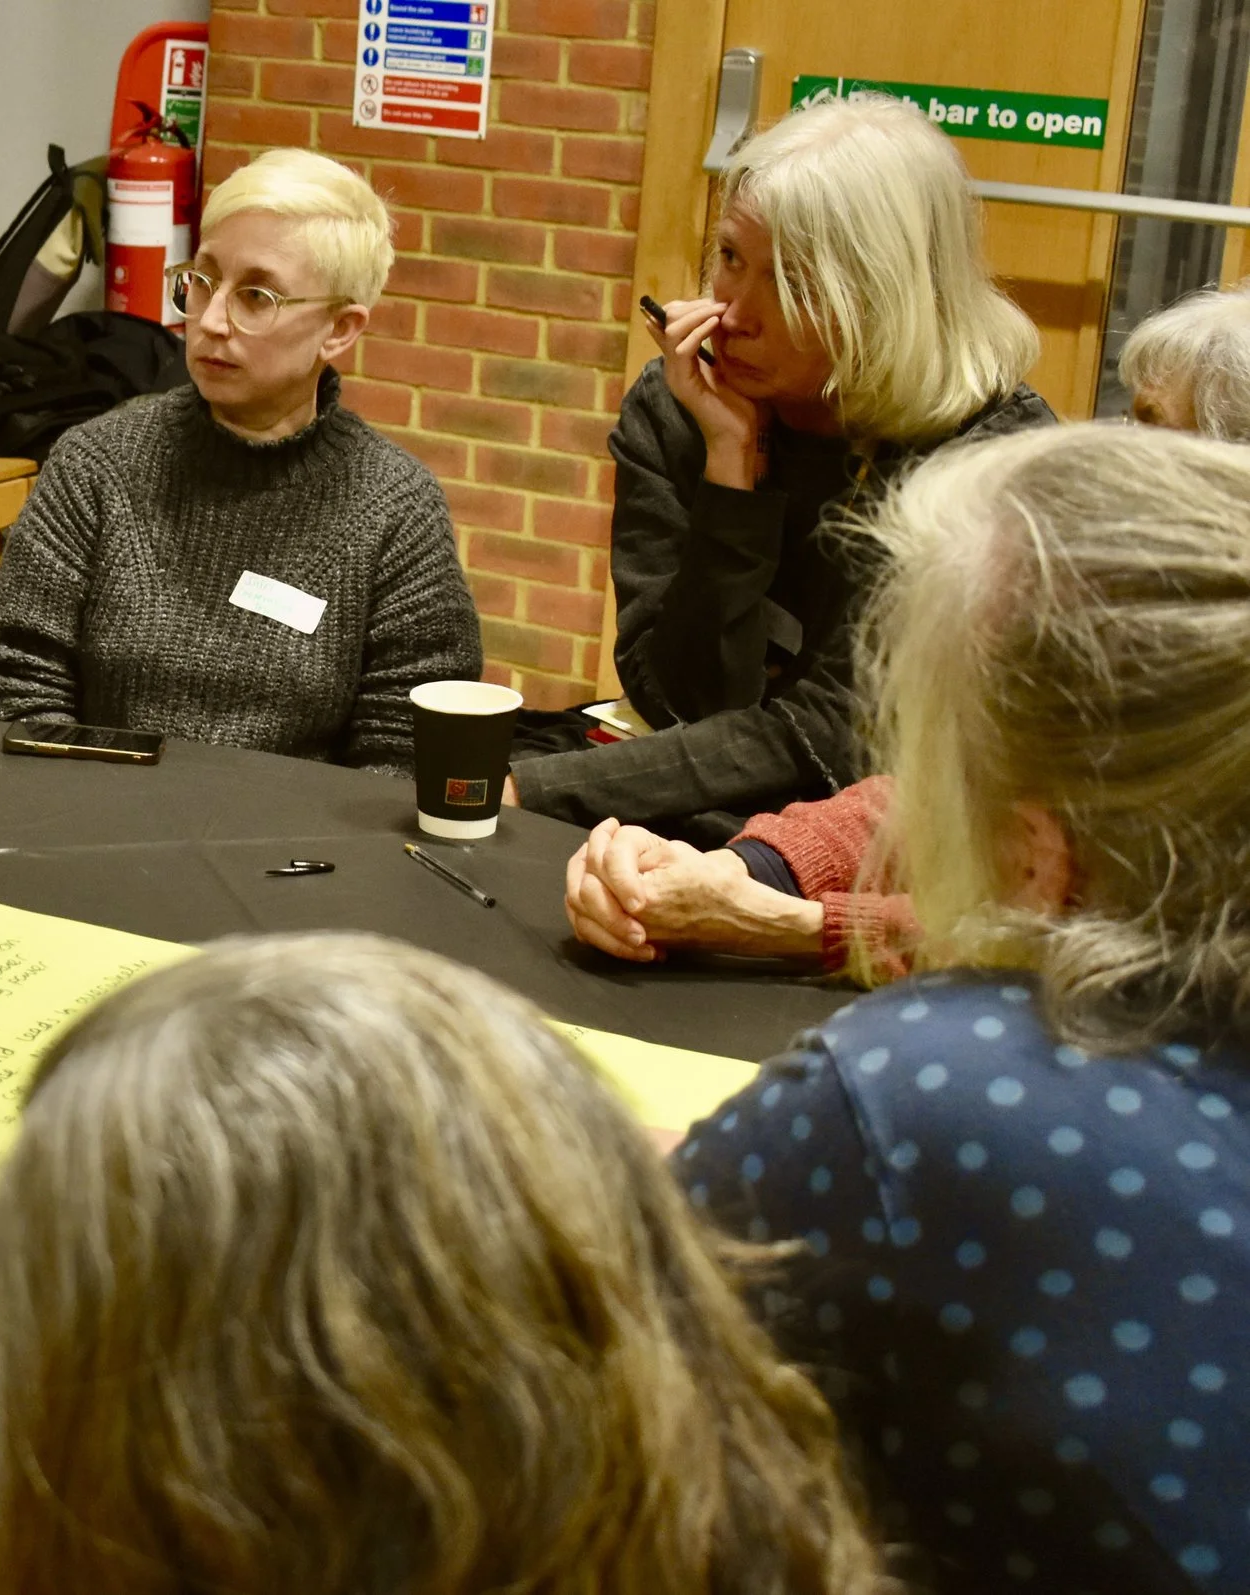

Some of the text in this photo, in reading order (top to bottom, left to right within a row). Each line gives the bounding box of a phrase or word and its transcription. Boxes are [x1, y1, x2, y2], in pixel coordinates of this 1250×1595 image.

[928, 98, 979, 125] bar
[987, 103, 1018, 128] to
[1026, 111, 1102, 138] open
